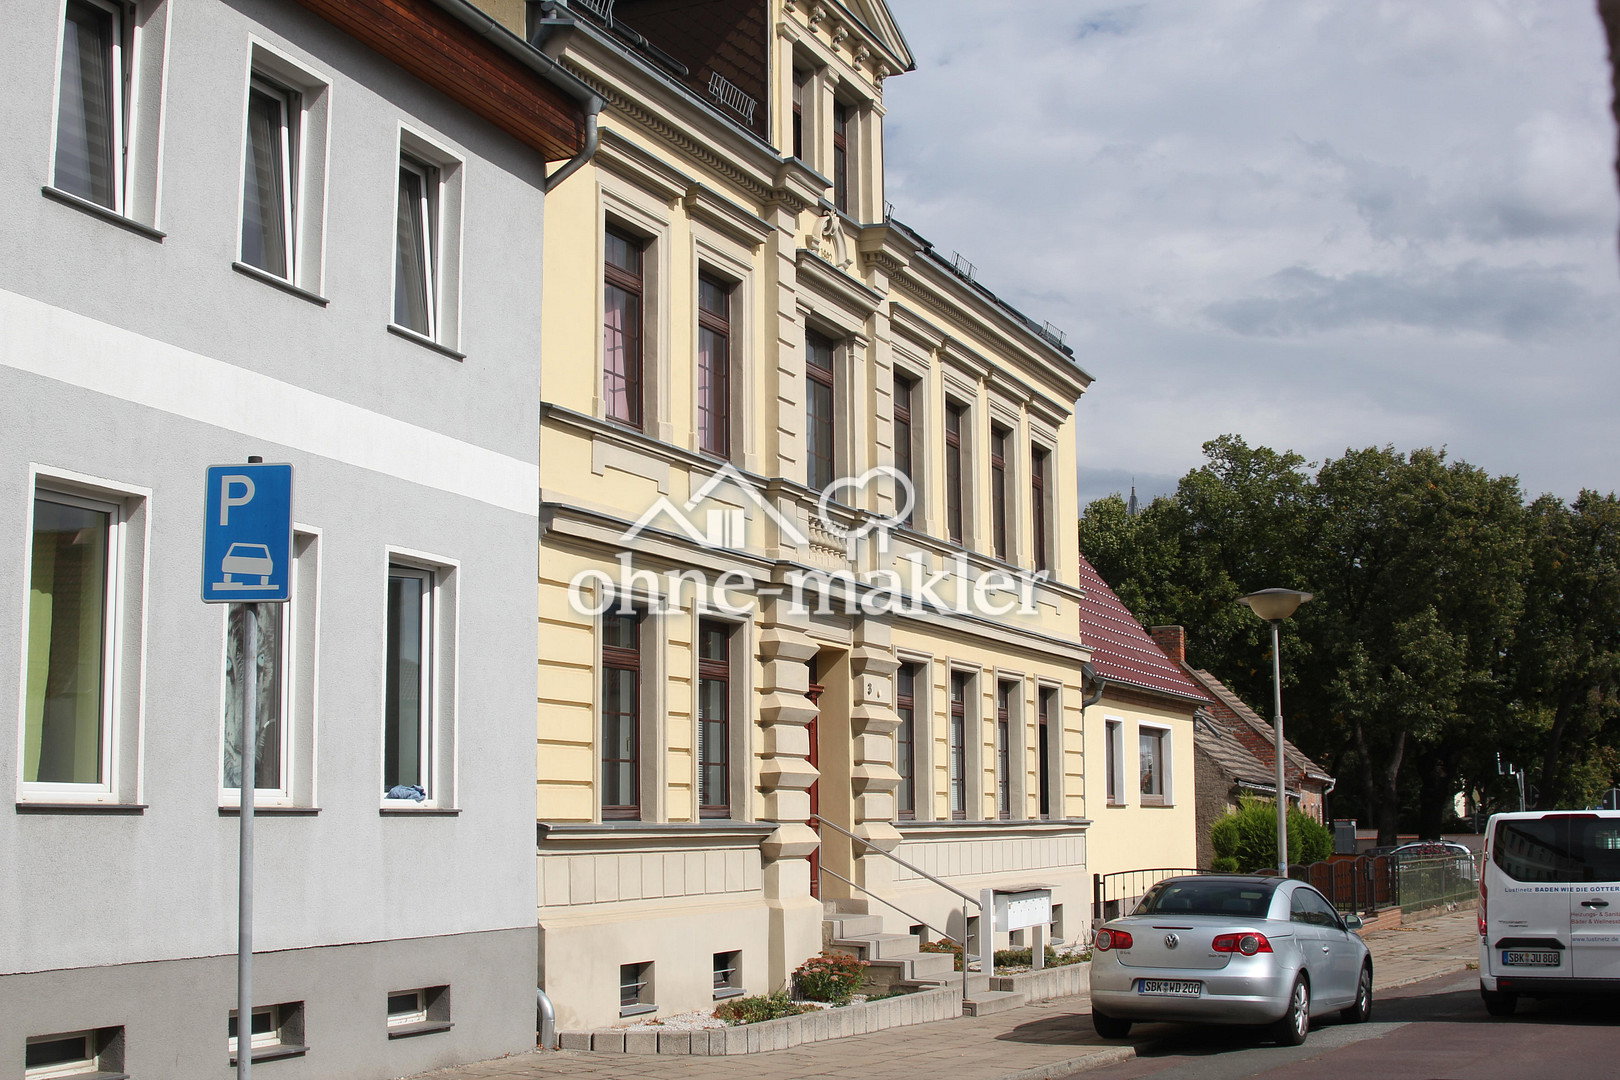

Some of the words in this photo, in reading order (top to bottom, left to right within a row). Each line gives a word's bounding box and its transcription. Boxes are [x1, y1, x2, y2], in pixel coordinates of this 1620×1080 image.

[219, 474, 256, 526] P
[866, 682, 873, 696] 3
[1508, 953, 1525, 963] SBK
[1530, 953, 1542, 963] JU
[1542, 953, 1558, 963] 808
[1145, 981, 1163, 992] SBK
[1169, 982, 1181, 993] WD
[1182, 982, 1200, 994] 200
